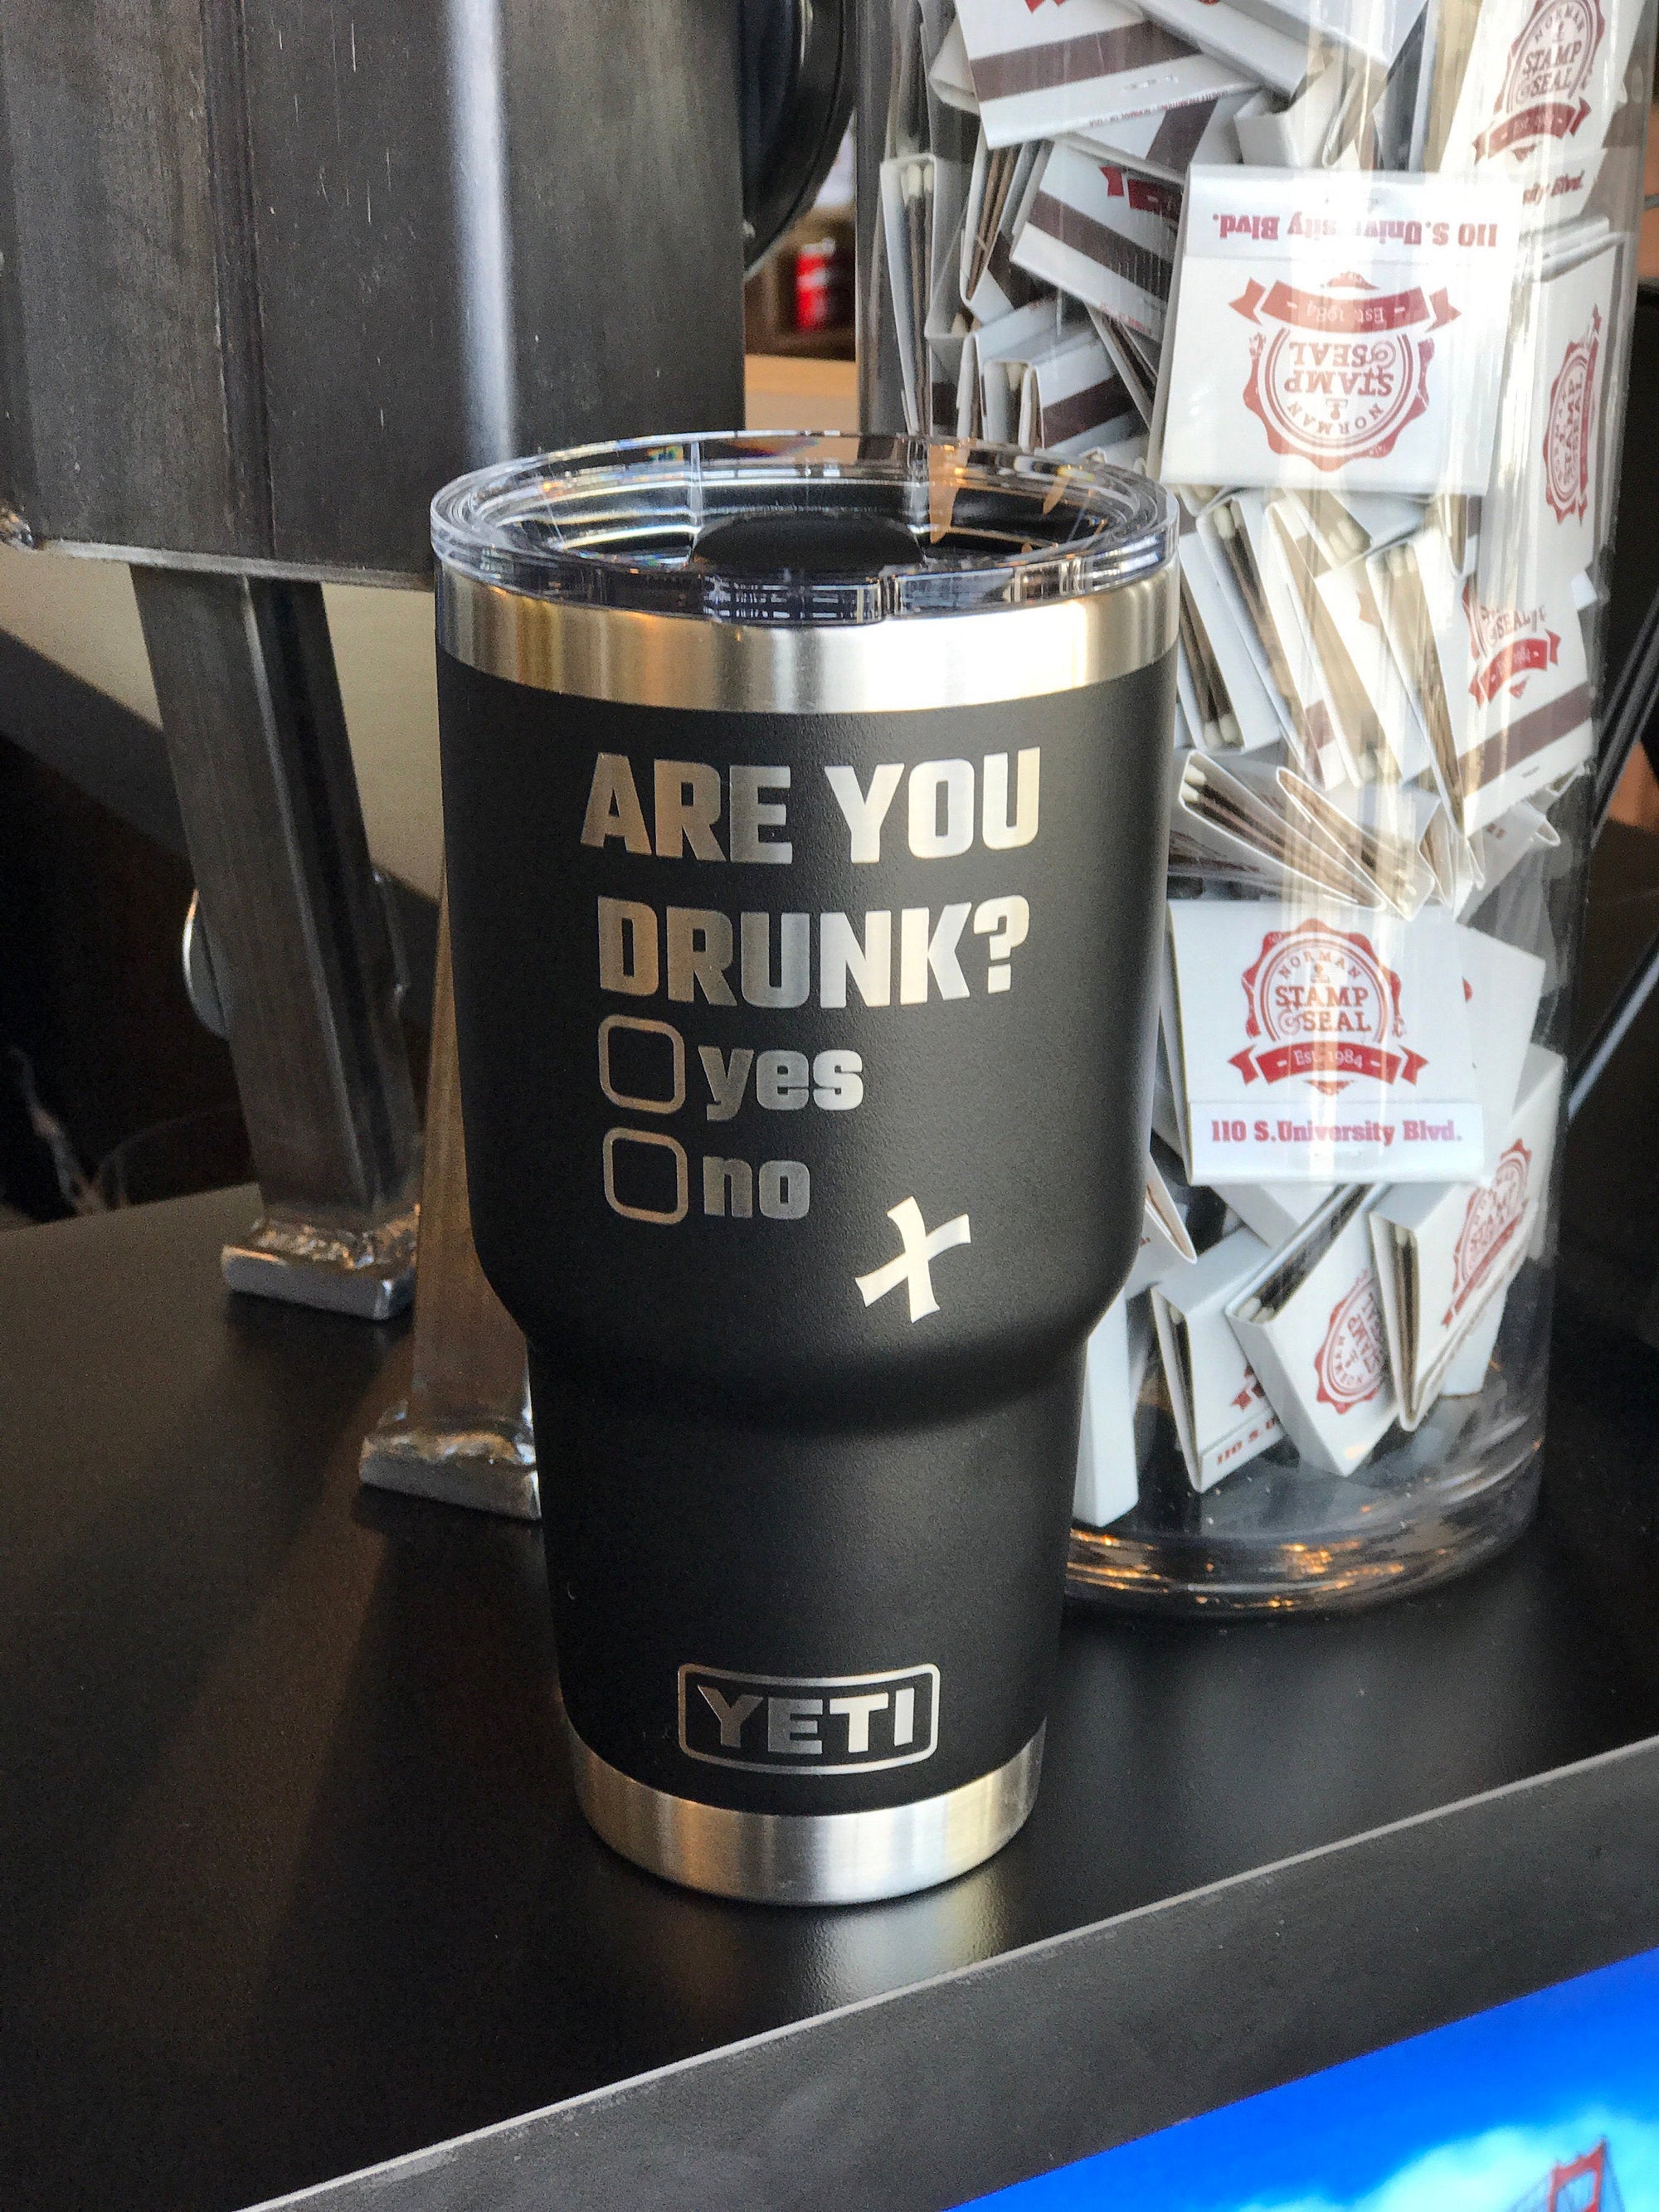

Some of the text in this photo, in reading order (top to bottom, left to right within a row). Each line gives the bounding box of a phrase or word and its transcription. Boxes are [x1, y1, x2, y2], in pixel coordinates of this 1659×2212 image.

[1213, 214, 1280, 241] Blvd.
[1457, 222, 1498, 248] 110
[1284, 370, 1394, 396] STAMP
[1287, 401, 1384, 435] NORMAN
[580, 747, 1041, 865] ARE YOU
[597, 894, 1030, 1009] DRUNK?
[1277, 950, 1362, 980] NORMAN
[1275, 984, 1370, 1008] STAMP
[698, 1044, 864, 1122] yes
[1212, 1120, 1246, 1142] 110
[1404, 1120, 1462, 1143] Blvd.
[703, 1155, 810, 1220] no
[697, 1685, 915, 1754] YETI
